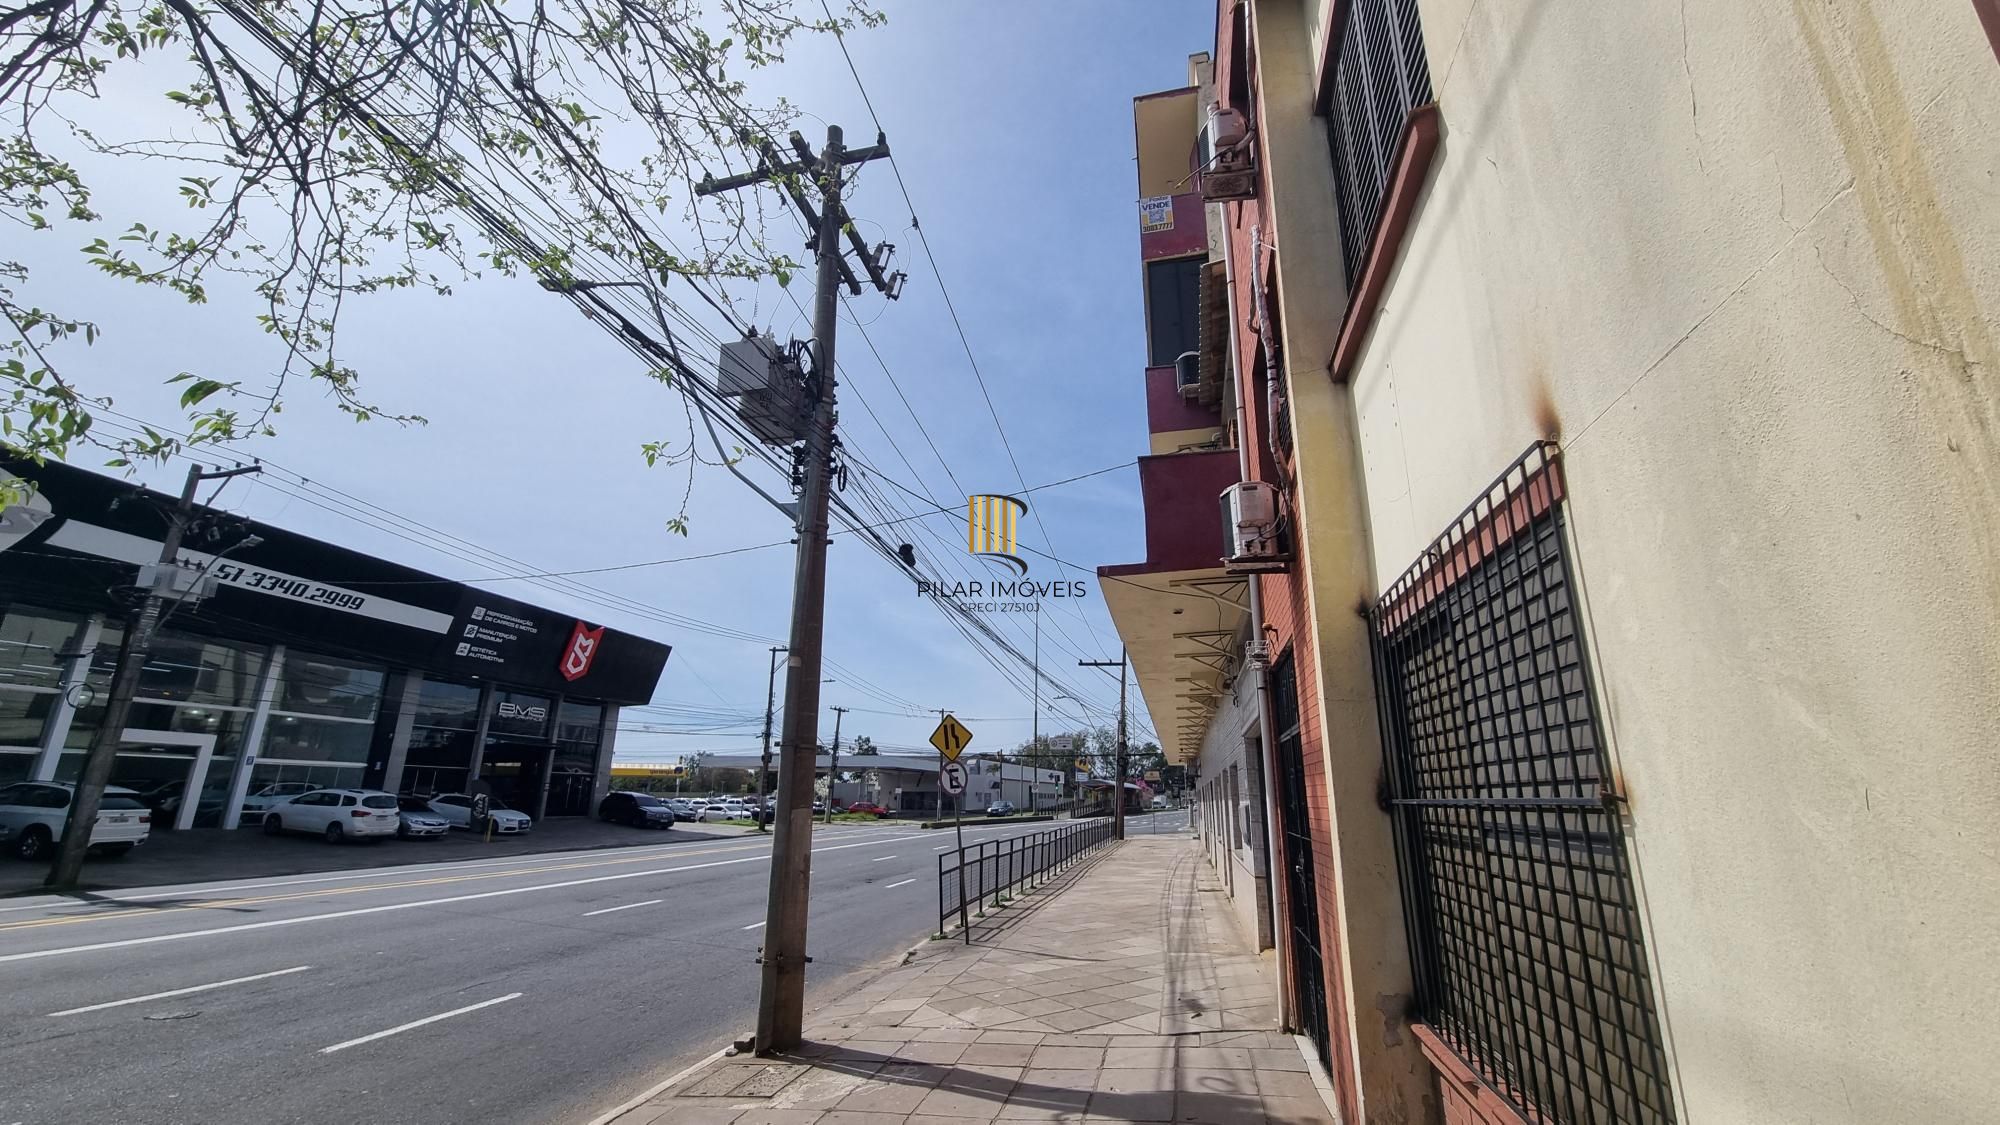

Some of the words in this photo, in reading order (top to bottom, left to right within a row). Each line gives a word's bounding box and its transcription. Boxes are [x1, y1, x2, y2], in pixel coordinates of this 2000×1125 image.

[1142, 201, 1171, 211] VENDE
[213, 563, 245, 582] 51
[245, 571, 365, 610] 3340.2999
[479, 627, 518, 641] MANUTENÇÃO
[493, 618, 515, 628] CARROS
[519, 625, 538, 634] MOTOS
[477, 633, 503, 643] PREMIUM
[499, 702, 546, 718] BMS
[948, 767, 960, 789] E
